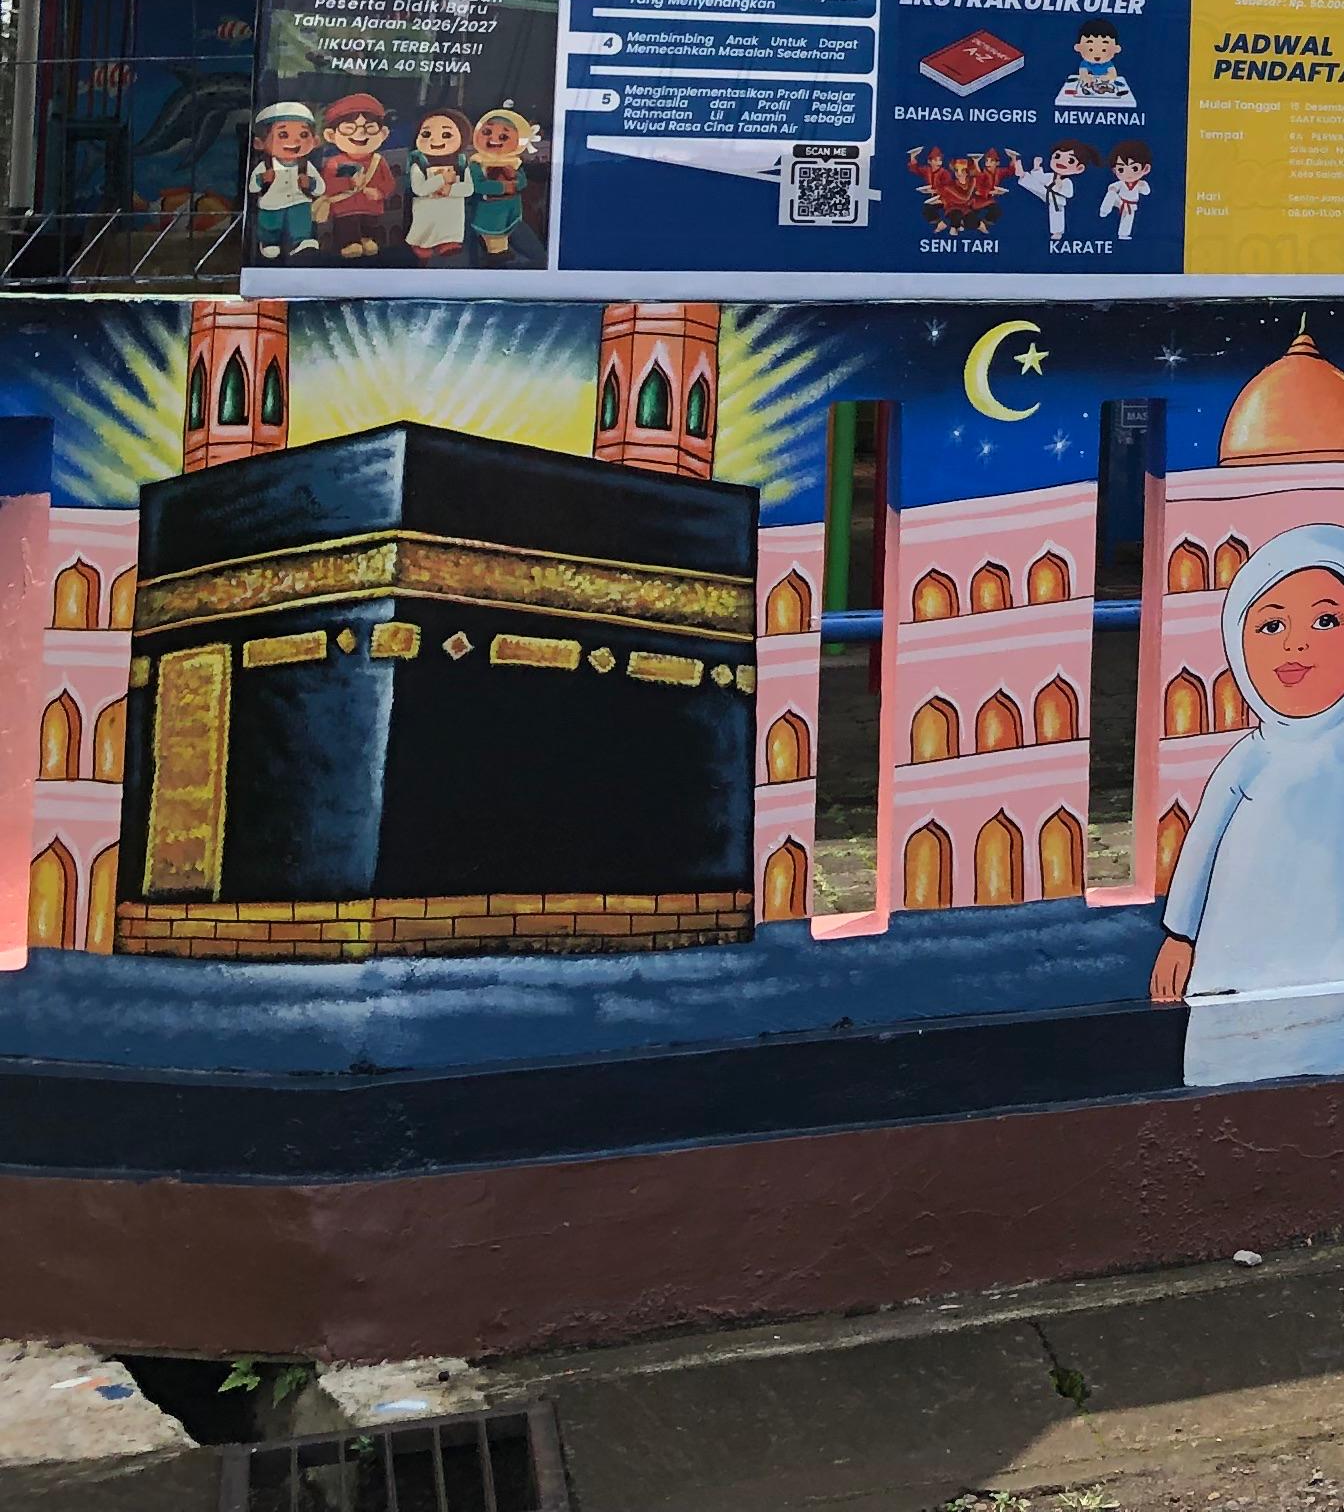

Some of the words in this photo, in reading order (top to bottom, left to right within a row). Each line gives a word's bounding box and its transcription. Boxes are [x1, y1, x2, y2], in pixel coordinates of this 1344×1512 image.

[393, 0, 438, 12] Didik
[445, 2, 488, 15] Baru
[293, 14, 347, 27] Tahun
[351, 16, 406, 32] Ajaran
[412, 17, 498, 33] 2026/2027
[1213, 32, 1333, 56] JADWAL
[331, 58, 389, 71] HANYA
[394, 60, 415, 72] 40
[420, 61, 472, 73] SISWA
[894, 106, 964, 121] BAHASA
[969, 108, 1036, 123] INGGRIS
[1054, 110, 1145, 125] MEWARNAI
[919, 238, 957, 252] SENI
[961, 239, 998, 252] TARI
[1049, 237, 1112, 253] KARATE
